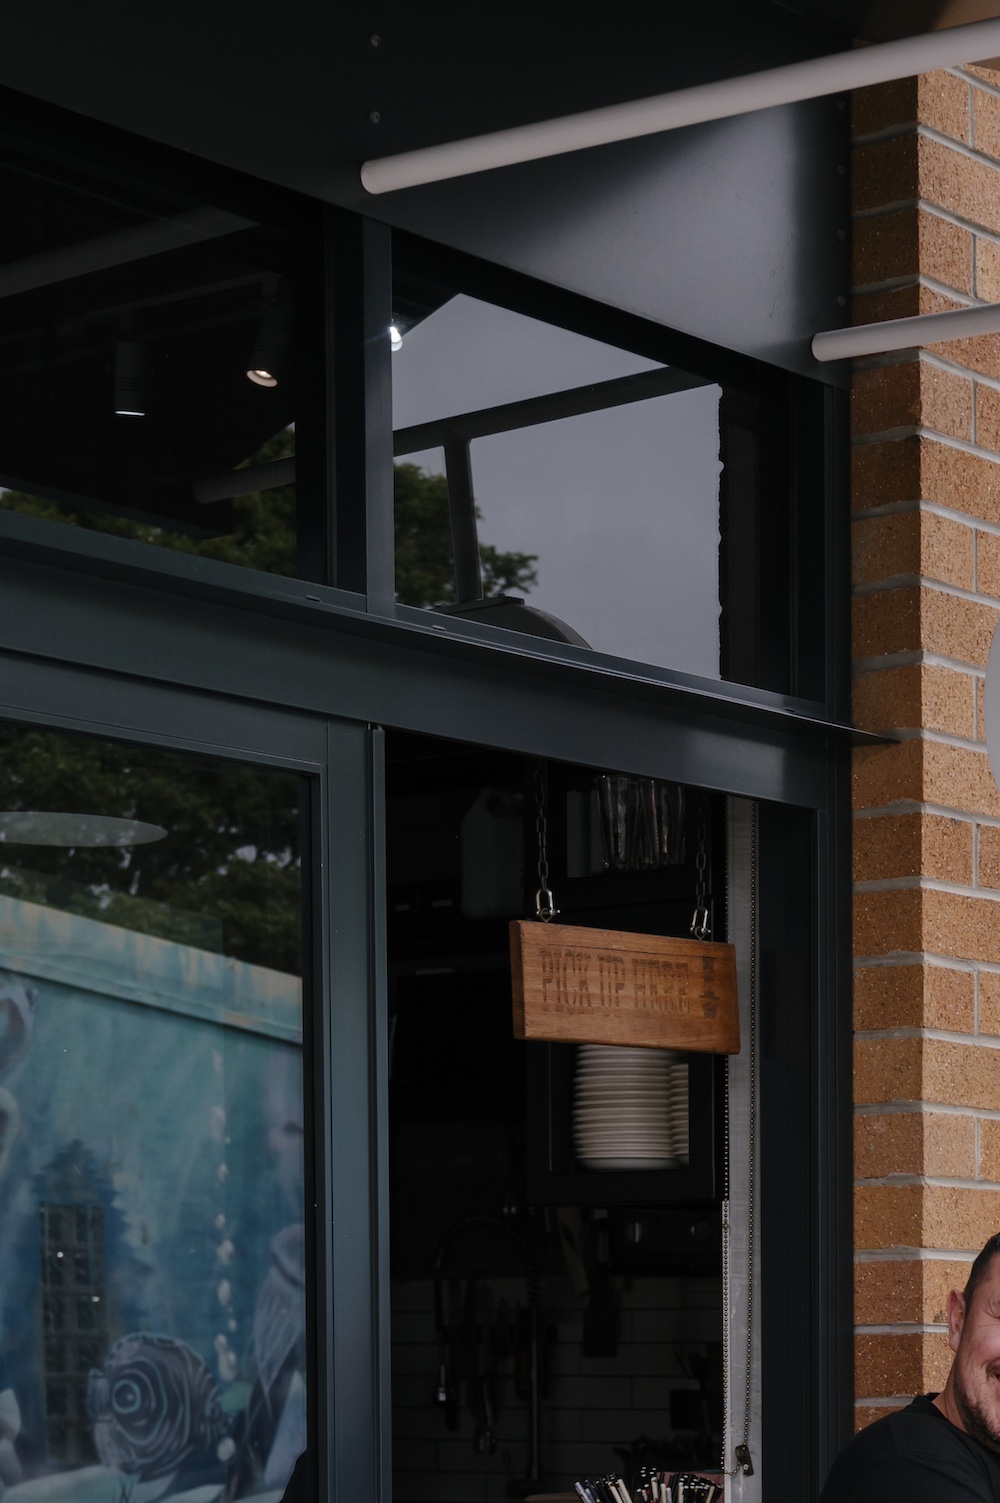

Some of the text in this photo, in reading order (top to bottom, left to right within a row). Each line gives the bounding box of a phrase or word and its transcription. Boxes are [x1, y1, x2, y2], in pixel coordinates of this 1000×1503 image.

[539, 947, 691, 1017] PICK UP HERE
